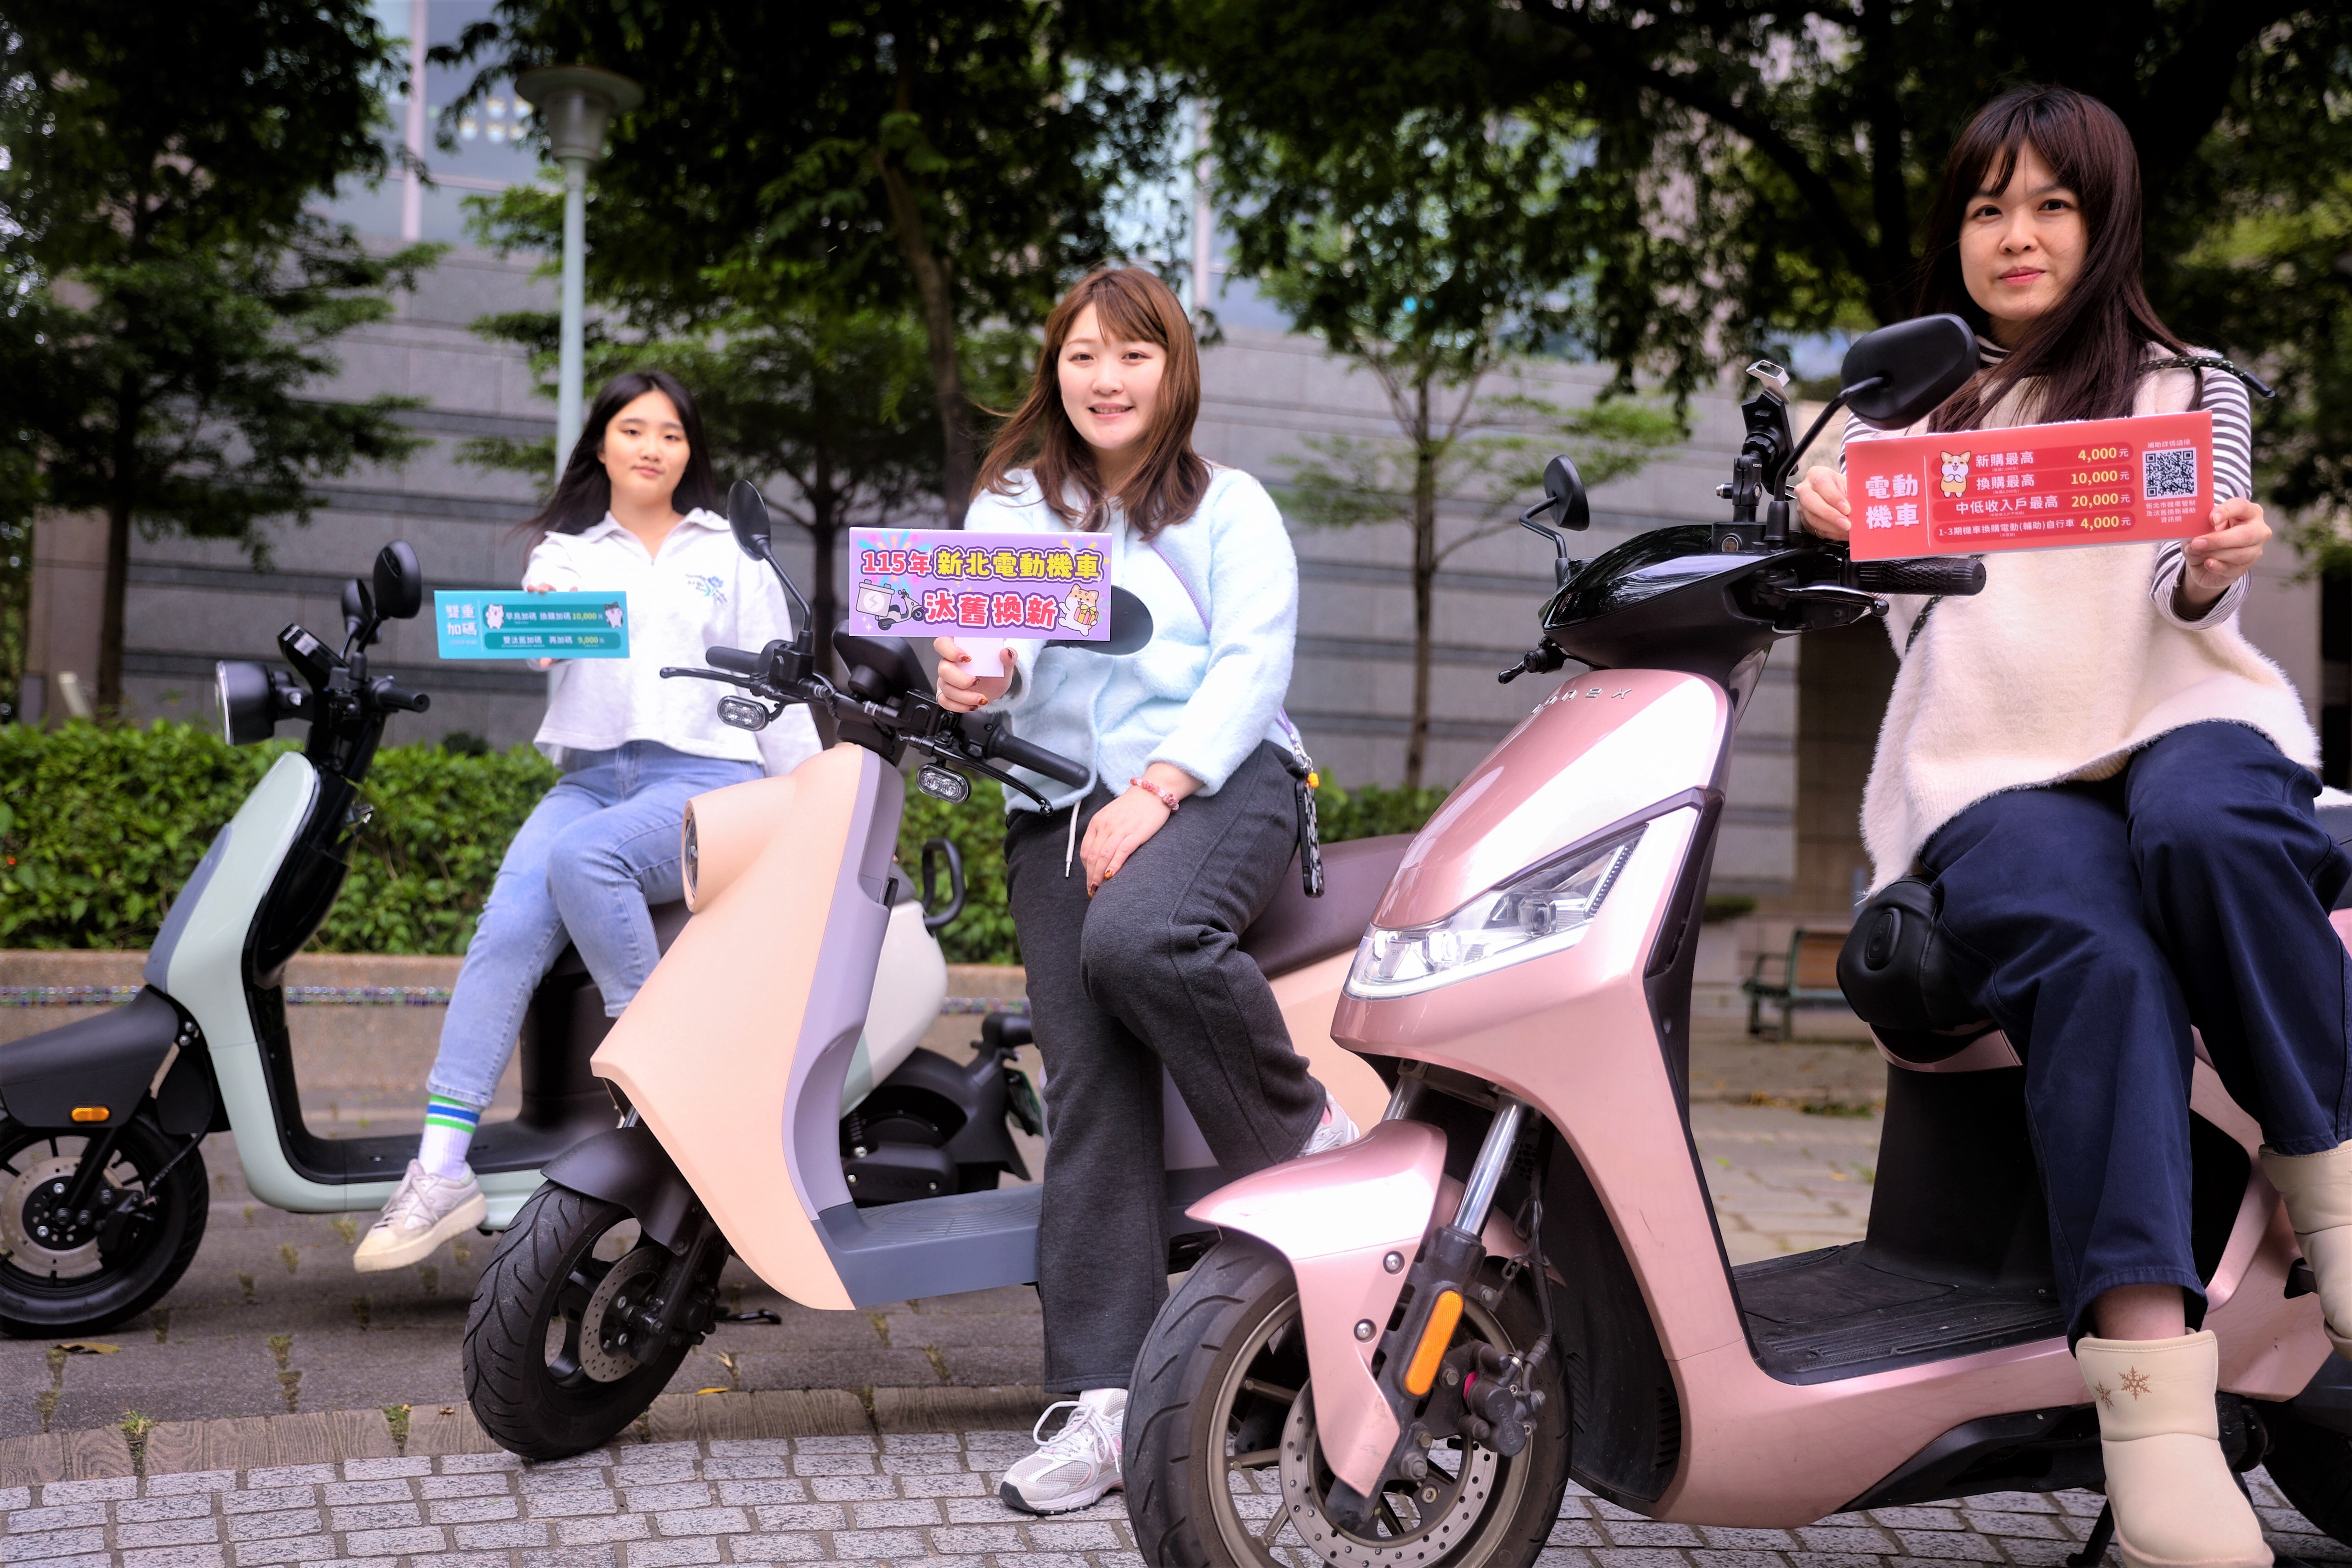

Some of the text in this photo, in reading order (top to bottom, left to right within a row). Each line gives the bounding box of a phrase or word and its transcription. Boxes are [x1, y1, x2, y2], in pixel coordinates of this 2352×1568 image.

[2147, 439, 2190, 448] 補助詳情請掃
[1975, 447, 2129, 468] 新購最高 4,000 元
[1866, 474, 1918, 499] 電動
[1976, 470, 2130, 490] 換購最高 10,000 元
[1955, 493, 2130, 515] 中低收入戶最高 20,000 元
[2146, 500, 2196, 509] 新北市機車管制
[1866, 503, 1919, 529] 機車
[2080, 516, 2119, 531] 4,000
[2121, 517, 2131, 526] 元
[925, 591, 1057, 629] 汰舊換新
